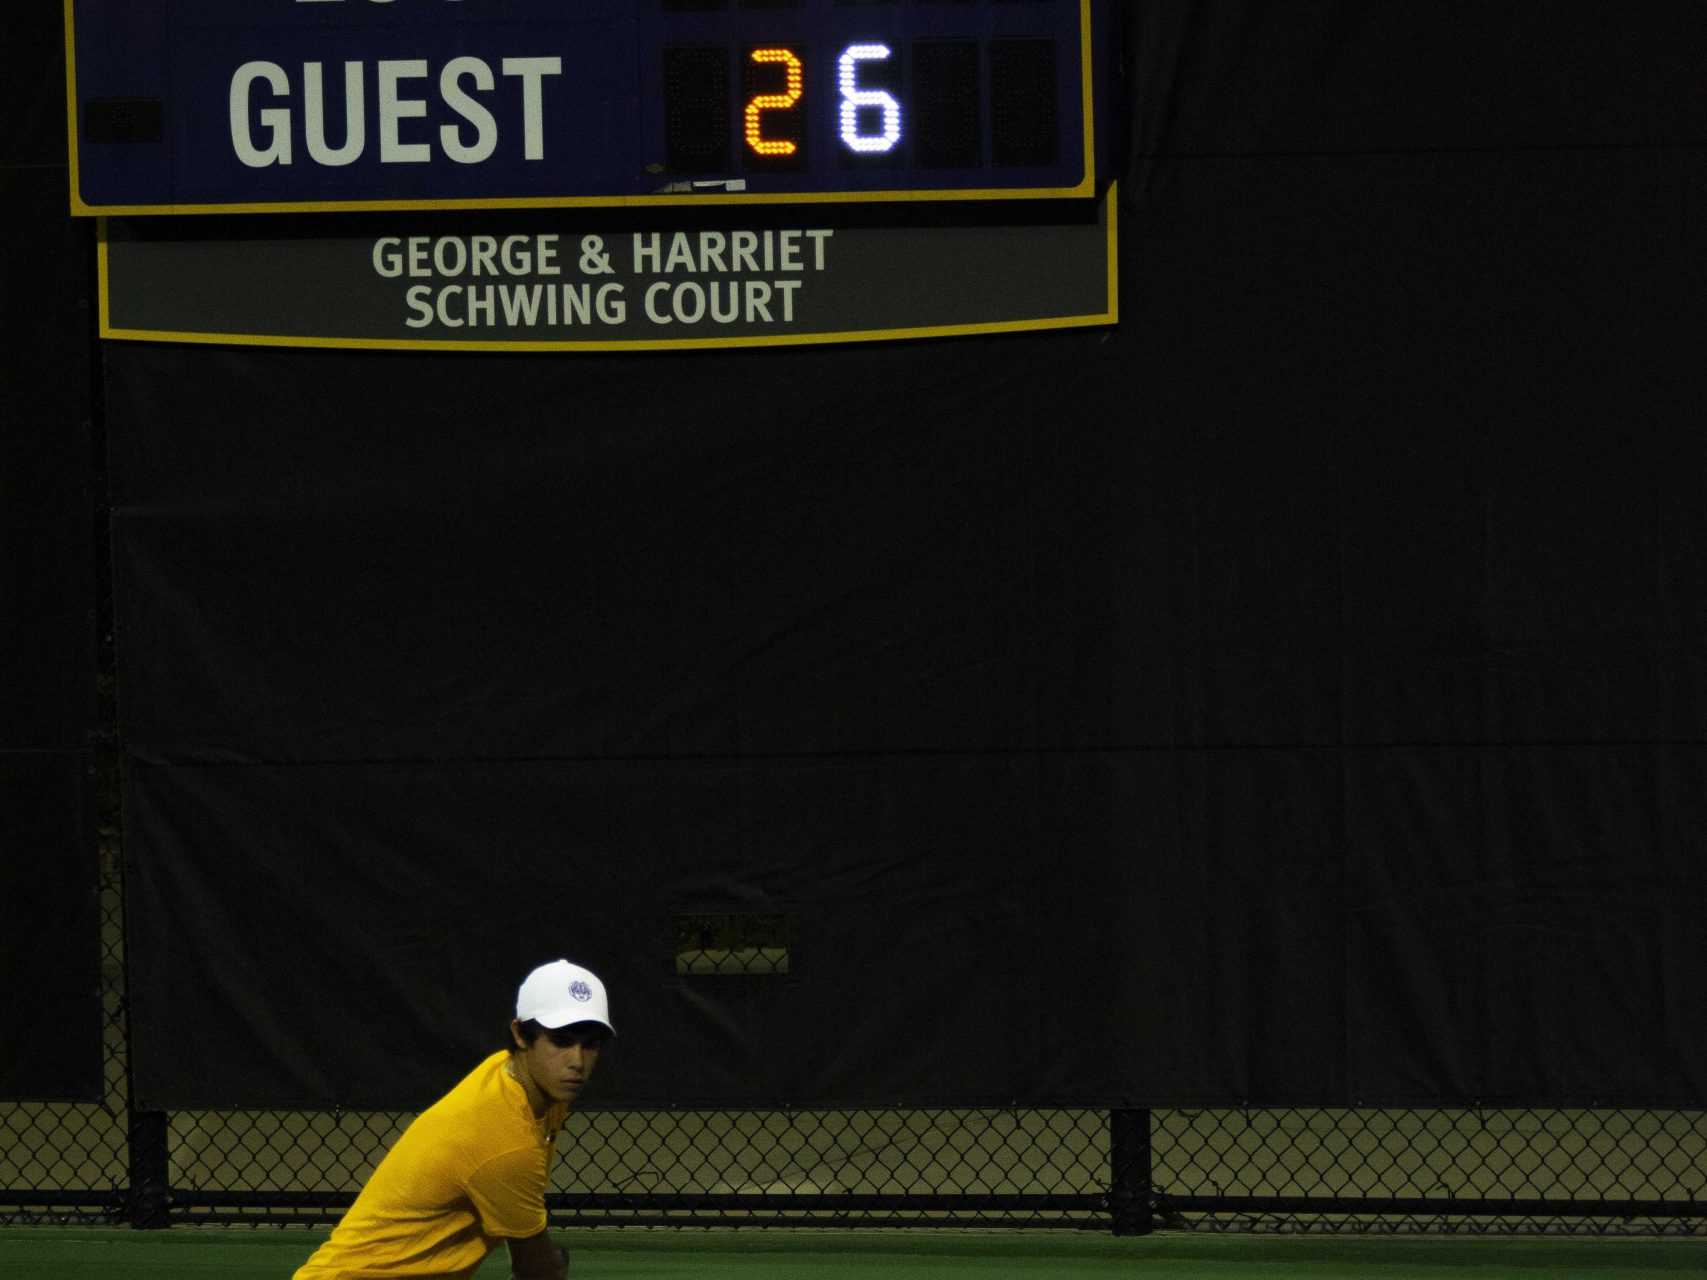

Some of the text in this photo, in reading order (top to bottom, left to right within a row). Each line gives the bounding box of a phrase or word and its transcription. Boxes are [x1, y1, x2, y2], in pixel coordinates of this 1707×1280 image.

[229, 56, 562, 168] GUEST
[745, 43, 900, 155] 2 6
[372, 229, 834, 278] GEORGE & HARRIET
[405, 280, 802, 328] SCHWING COURT
